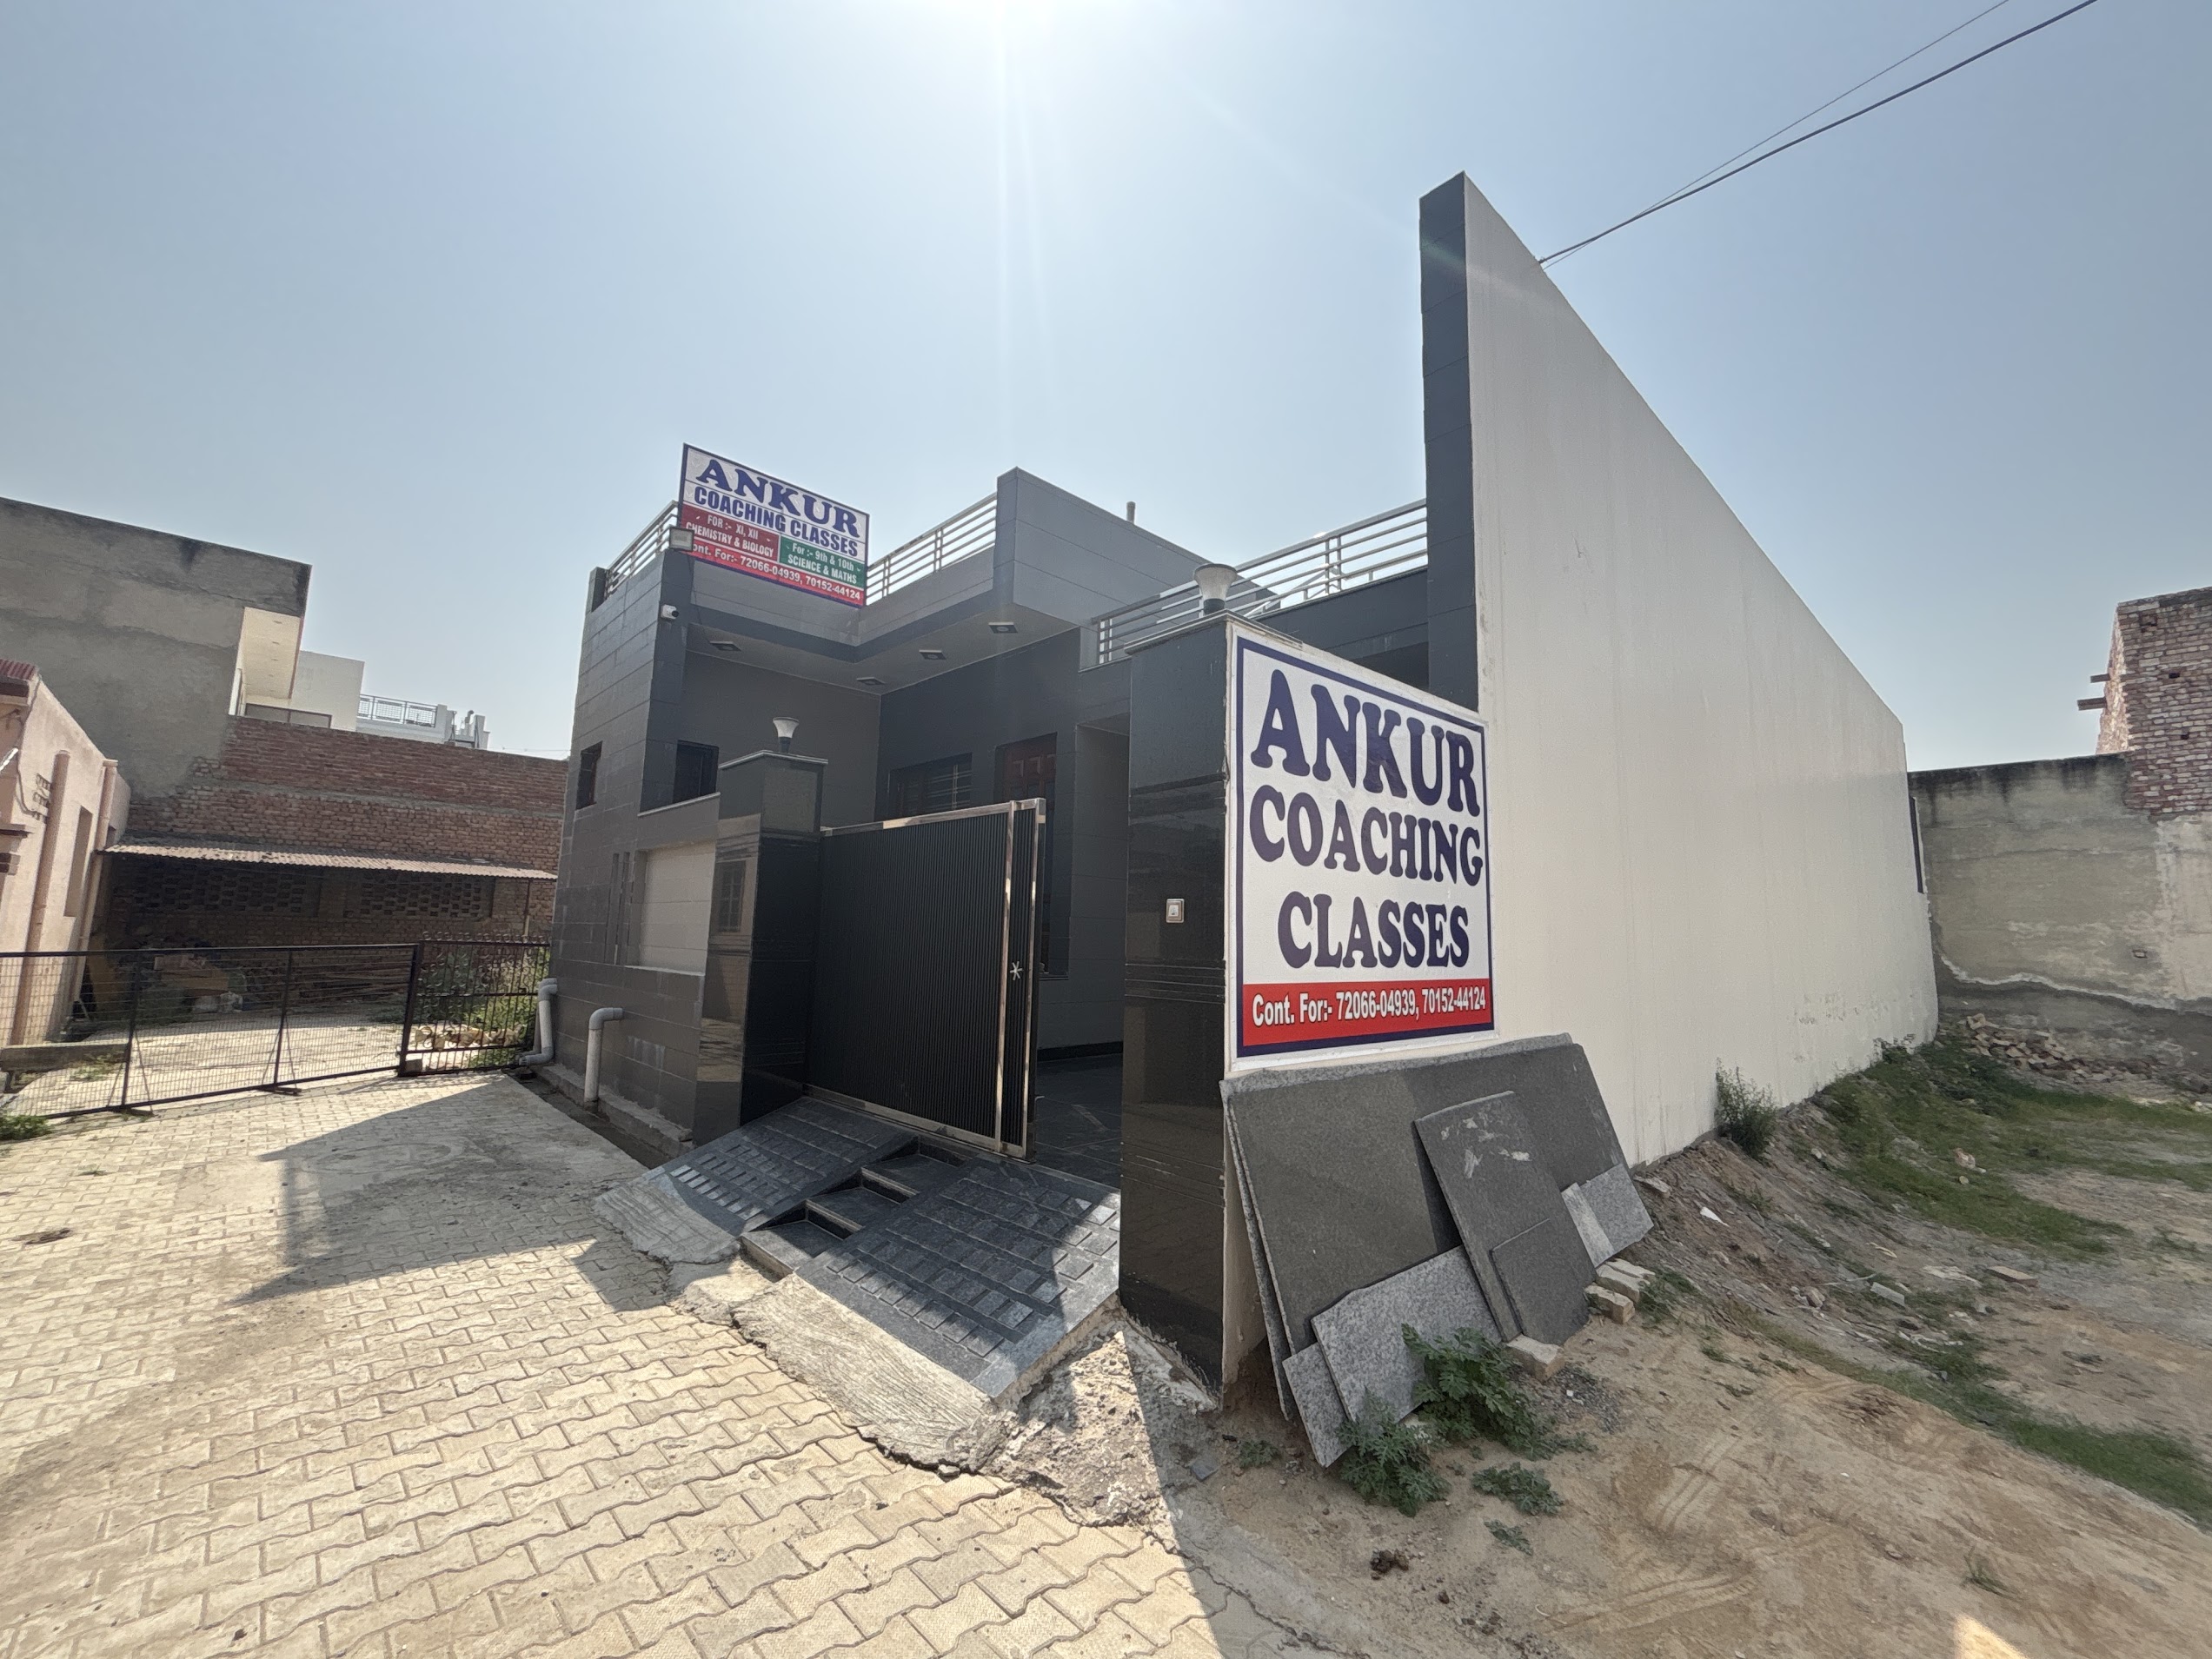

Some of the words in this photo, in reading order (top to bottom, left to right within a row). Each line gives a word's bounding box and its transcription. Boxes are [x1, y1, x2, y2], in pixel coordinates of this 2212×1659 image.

[694, 486, 786, 534] COACHING
[790, 520, 858, 557] CLASSES
[695, 459, 860, 538] ANKUR
[686, 521, 733, 545] CHEMISTRY
[734, 538, 741, 547] &
[742, 540, 774, 558] BIOLOGY
[735, 524, 747, 537] XI,
[747, 528, 759, 540] XII
[693, 544, 712, 556] ont.
[740, 555, 802, 585] 72066-04939,
[806, 575, 860, 601] 70152-44124
[787, 554, 821, 574] SCIENCE
[823, 565, 829, 575] &
[831, 567, 857, 584] MATHS
[815, 551, 827, 563] 9th
[829, 555, 835, 565] &
[838, 558, 854, 572] 10th
[1250, 668, 1480, 817] ANKUR
[1249, 784, 1484, 887] COACHING
[1277, 891, 1471, 969] CLASSES
[1252, 993, 1294, 1026] Cont.
[1299, 992, 1332, 1023] For:-
[1335, 988, 1419, 1021] 72066-04939,
[1422, 985, 1486, 1014] 70152-44124
